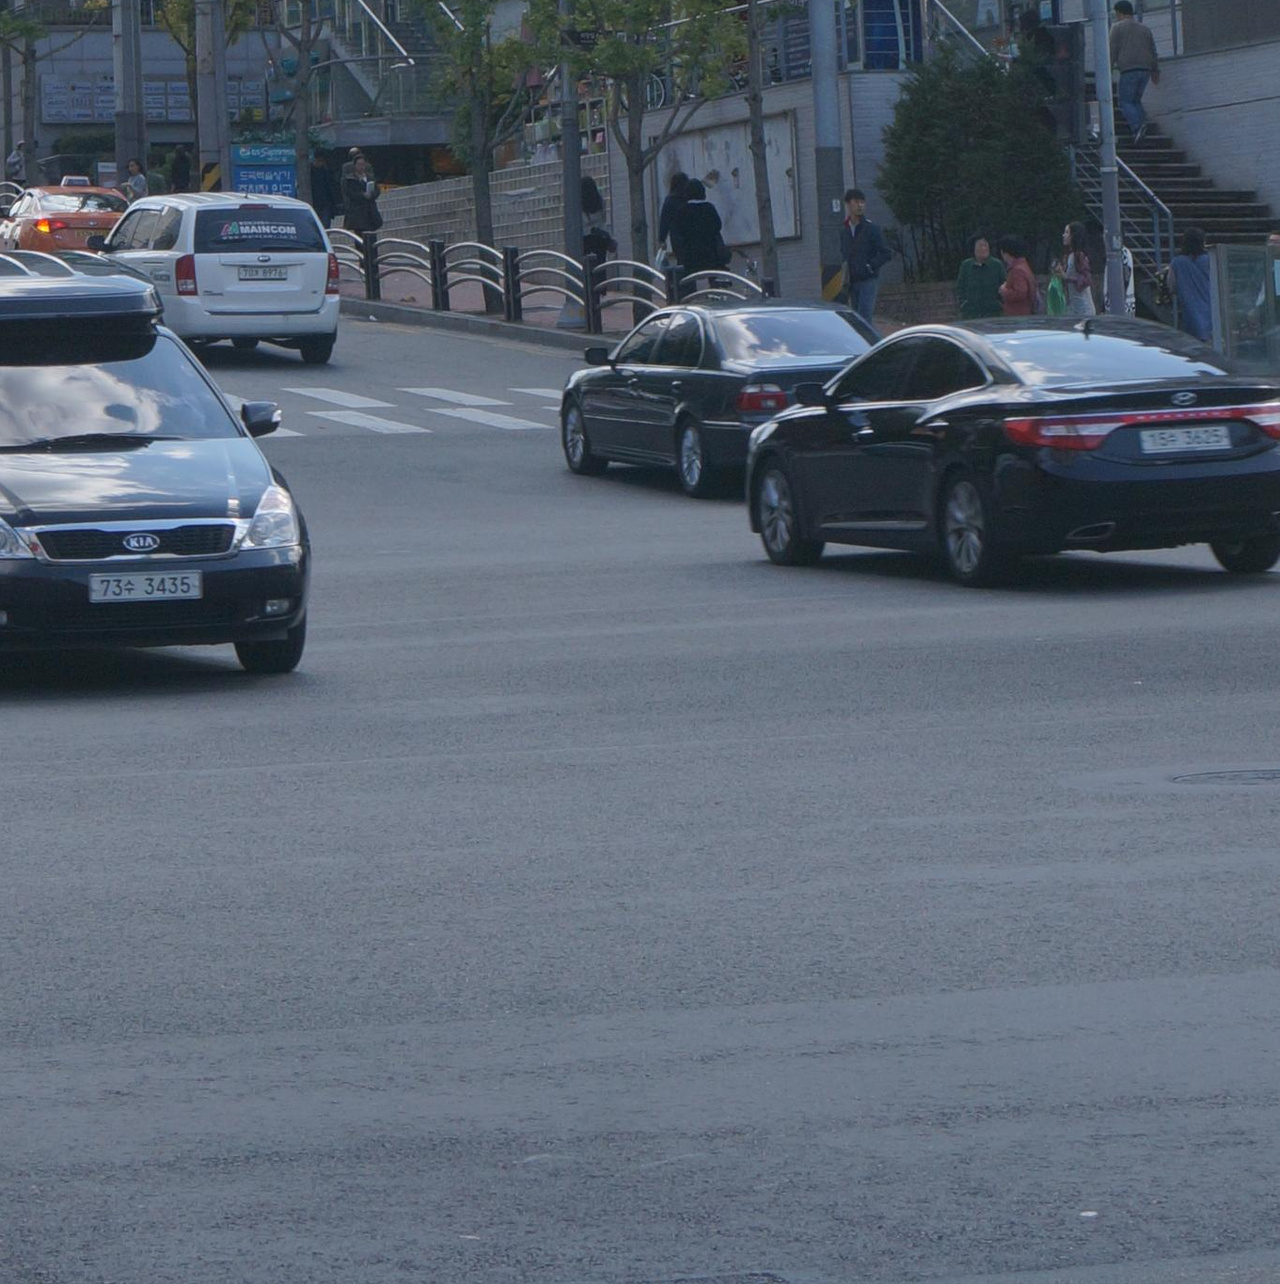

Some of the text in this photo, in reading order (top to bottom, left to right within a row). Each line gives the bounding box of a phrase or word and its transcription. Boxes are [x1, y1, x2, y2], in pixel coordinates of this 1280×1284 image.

[239, 225, 297, 234] MAINCOM
[128, 535, 155, 548] KIA
[99, 576, 191, 597] 73수 3435
